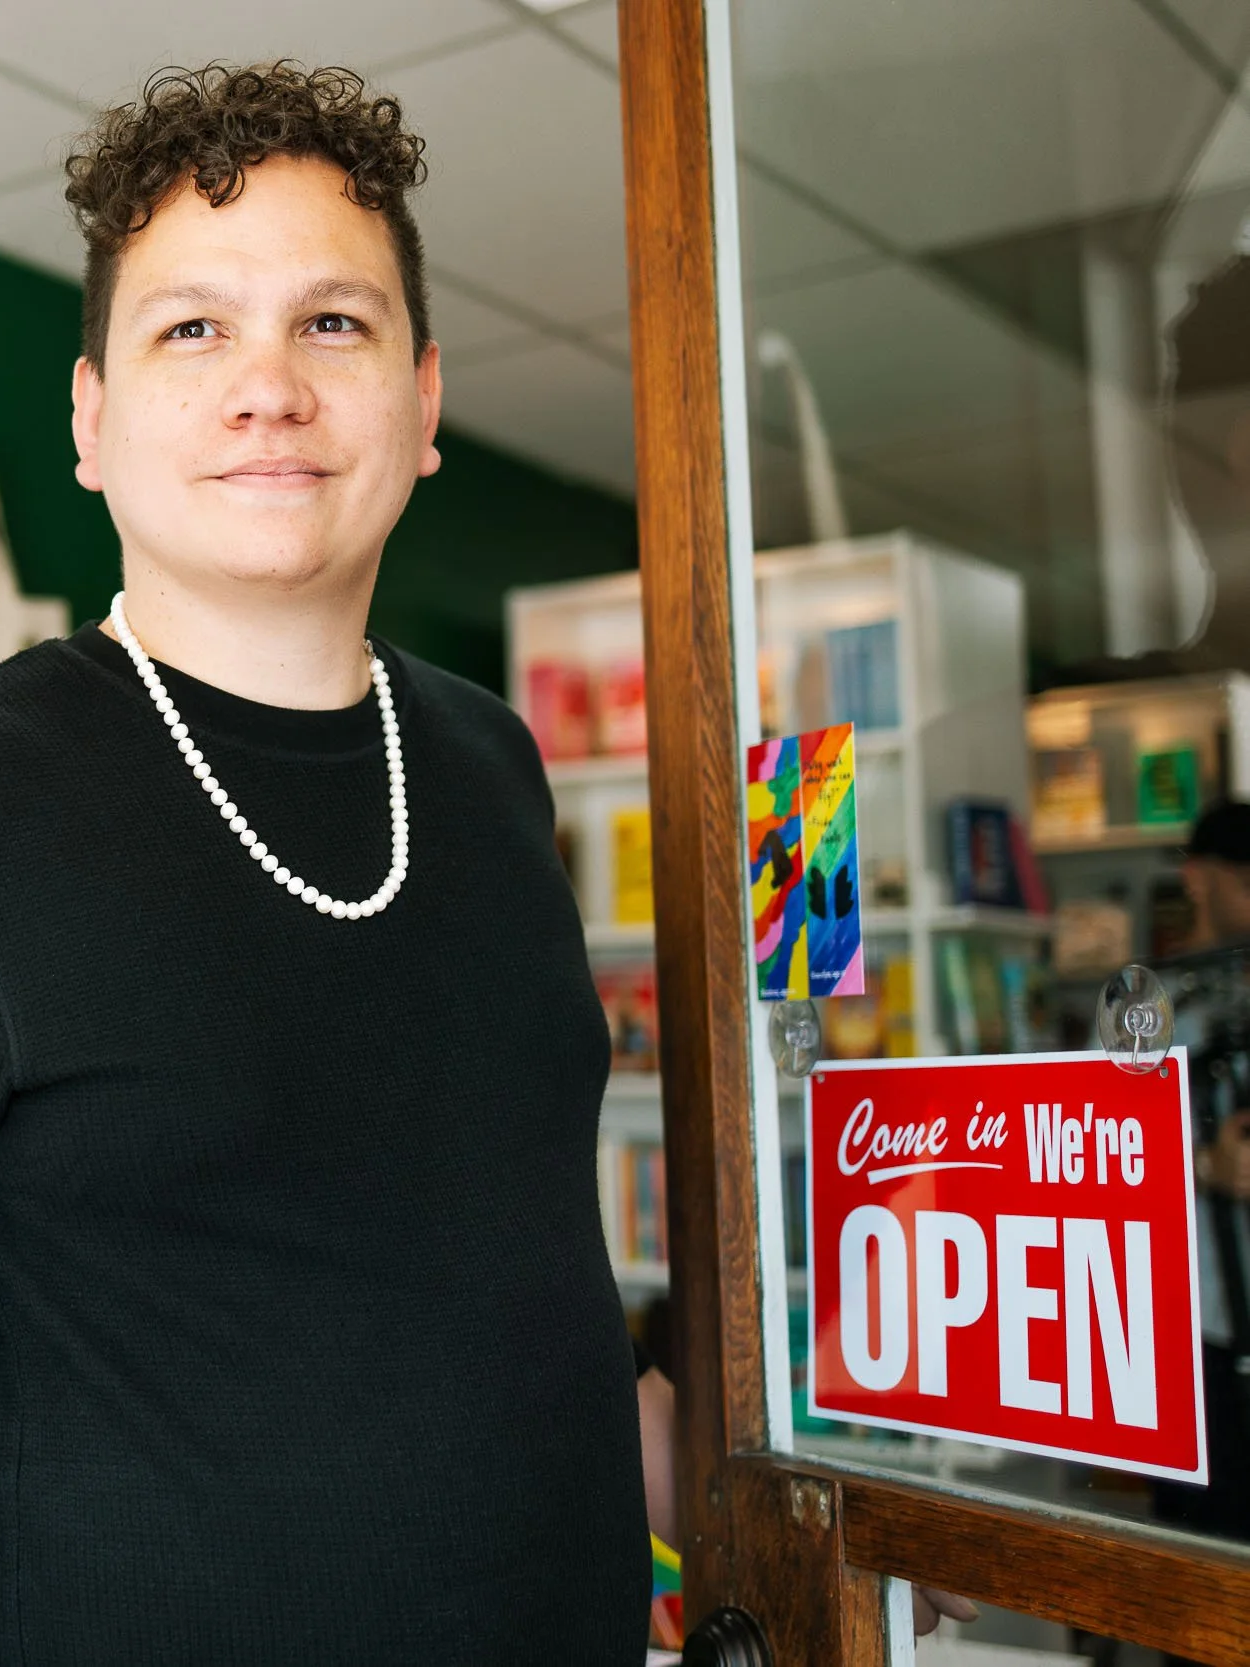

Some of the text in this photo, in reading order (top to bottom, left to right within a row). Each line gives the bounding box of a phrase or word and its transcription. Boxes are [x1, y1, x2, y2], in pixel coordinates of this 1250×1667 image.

[837, 1097, 1145, 1187] Come in We're
[838, 1204, 1158, 1431] OPEN
